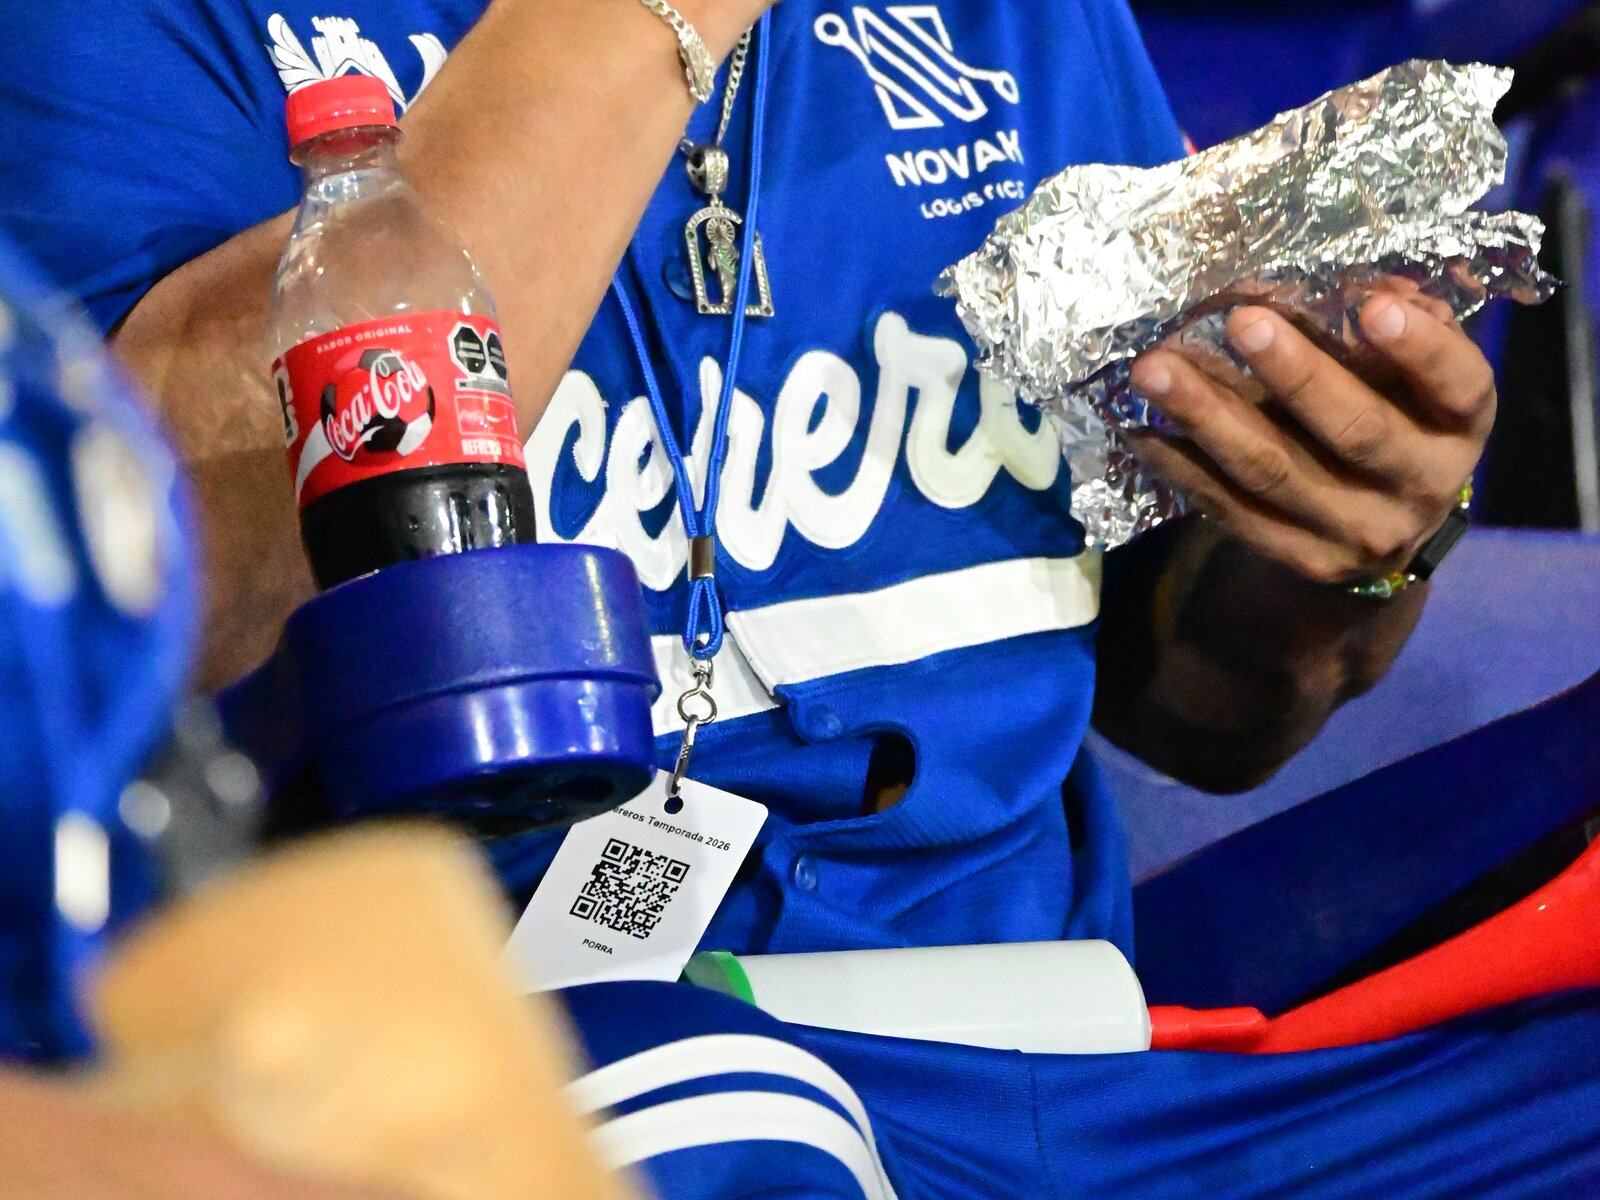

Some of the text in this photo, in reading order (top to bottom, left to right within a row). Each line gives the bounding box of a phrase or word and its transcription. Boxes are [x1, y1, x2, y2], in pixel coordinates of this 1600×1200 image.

[885, 129, 1025, 187] NOVAK
[316, 324, 412, 354] SABOR ORIGINAL
[612, 806, 731, 852] ereros Temporada 2026
[582, 938, 613, 955] PORRA
